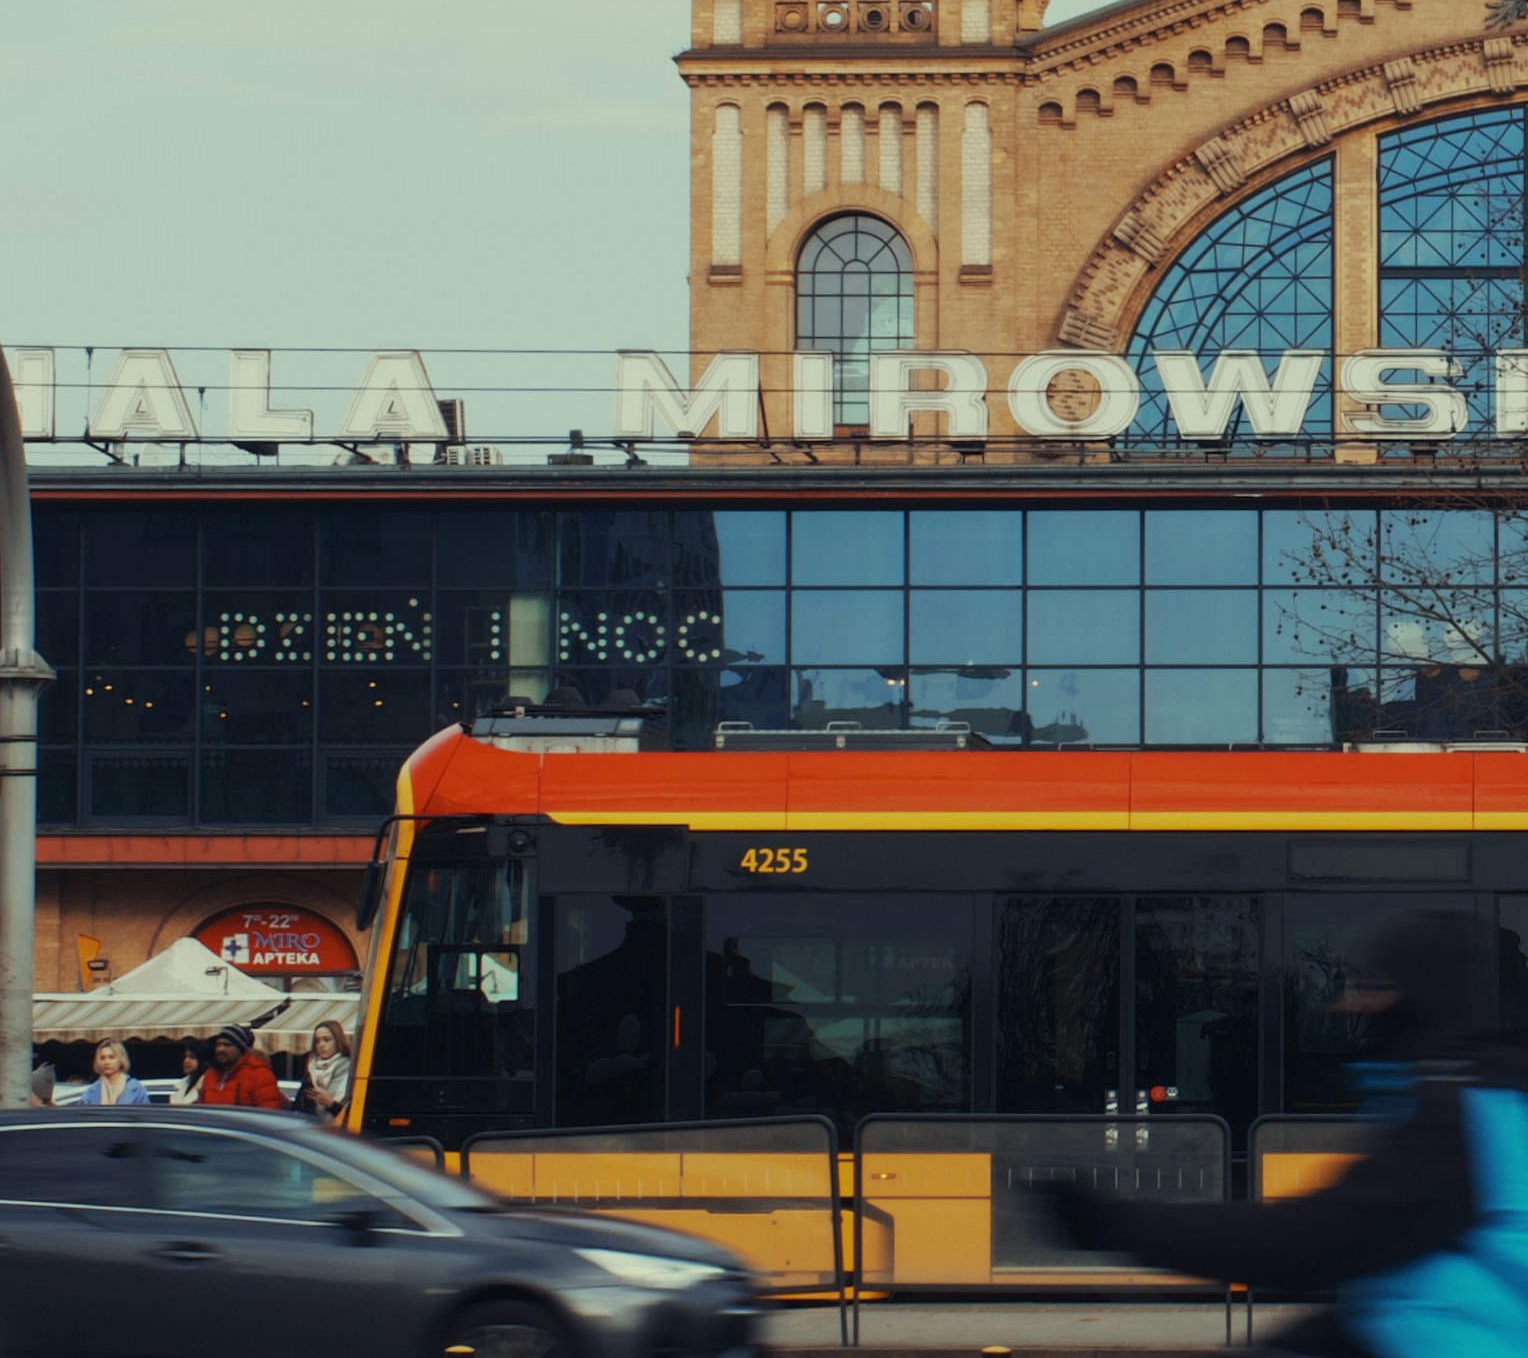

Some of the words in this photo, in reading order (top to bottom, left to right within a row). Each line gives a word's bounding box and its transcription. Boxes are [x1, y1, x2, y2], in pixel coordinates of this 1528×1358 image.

[221, 598, 432, 662] DZIEŃ
[560, 610, 721, 662] NOC
[740, 848, 809, 873] 4255
[252, 931, 320, 951] MIRO
[253, 952, 320, 965] APTEKA
[898, 957, 953, 969] APTEK
